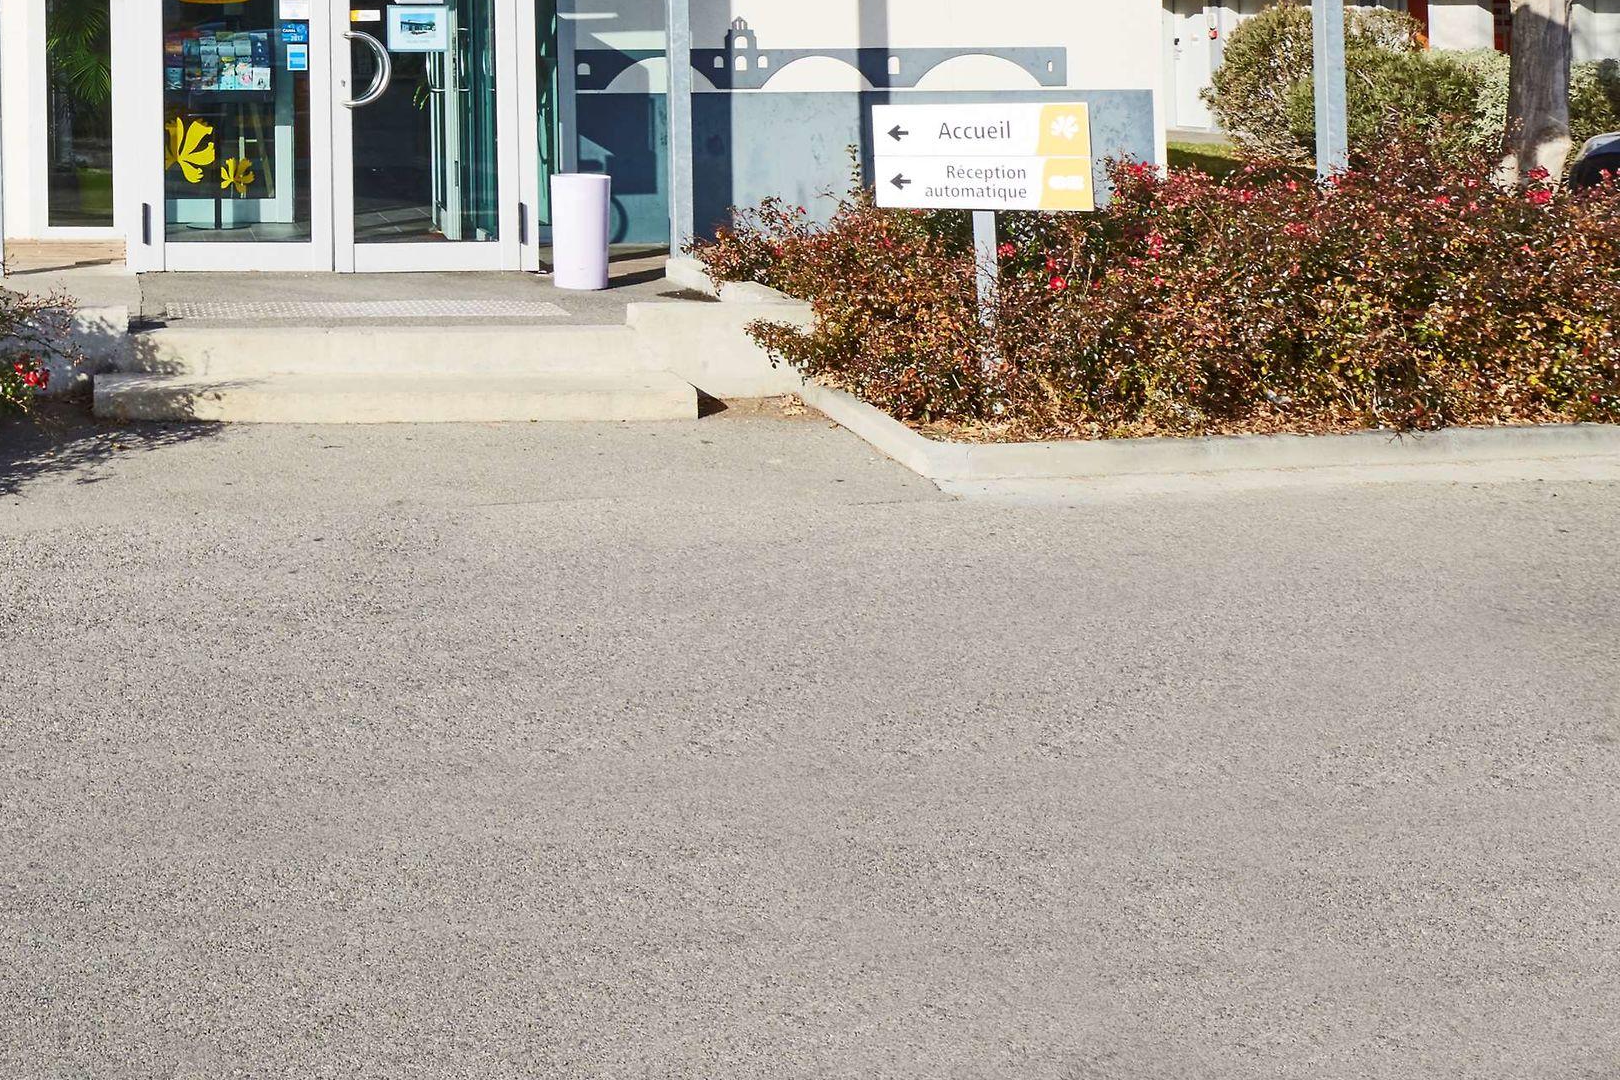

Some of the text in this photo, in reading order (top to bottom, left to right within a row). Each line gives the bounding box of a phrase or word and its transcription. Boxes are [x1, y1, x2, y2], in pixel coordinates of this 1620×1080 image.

[938, 121, 1011, 139] Accueil
[946, 165, 1026, 182] Réception
[924, 185, 1027, 202] automatique
